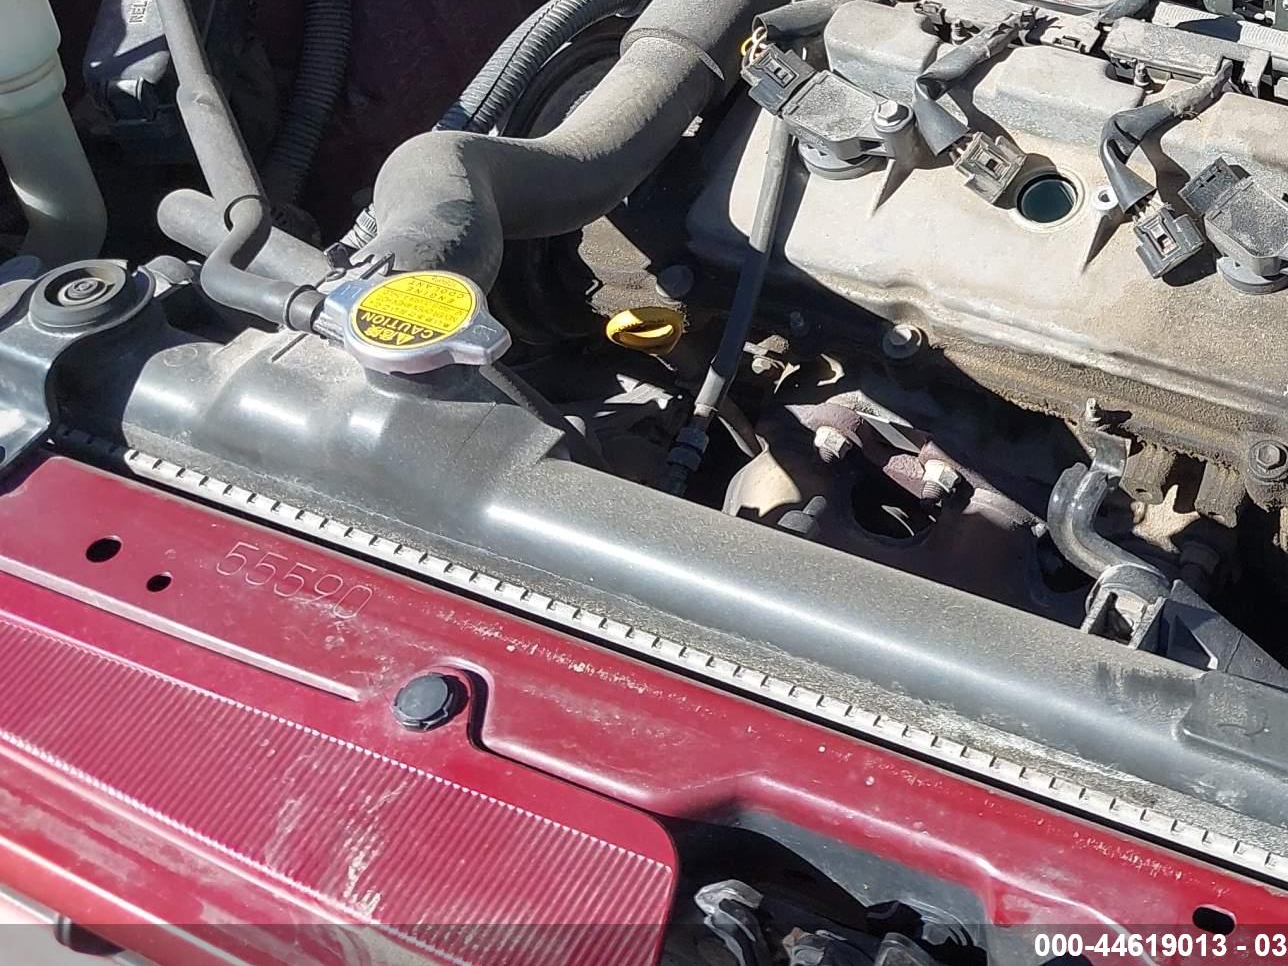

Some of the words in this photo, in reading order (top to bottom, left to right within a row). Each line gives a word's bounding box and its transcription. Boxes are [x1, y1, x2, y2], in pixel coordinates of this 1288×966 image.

[405, 285, 455, 304] ENGINE
[407, 279, 465, 299] COOLANT
[360, 311, 434, 339] CAUTION
[215, 541, 373, 619] 55590
